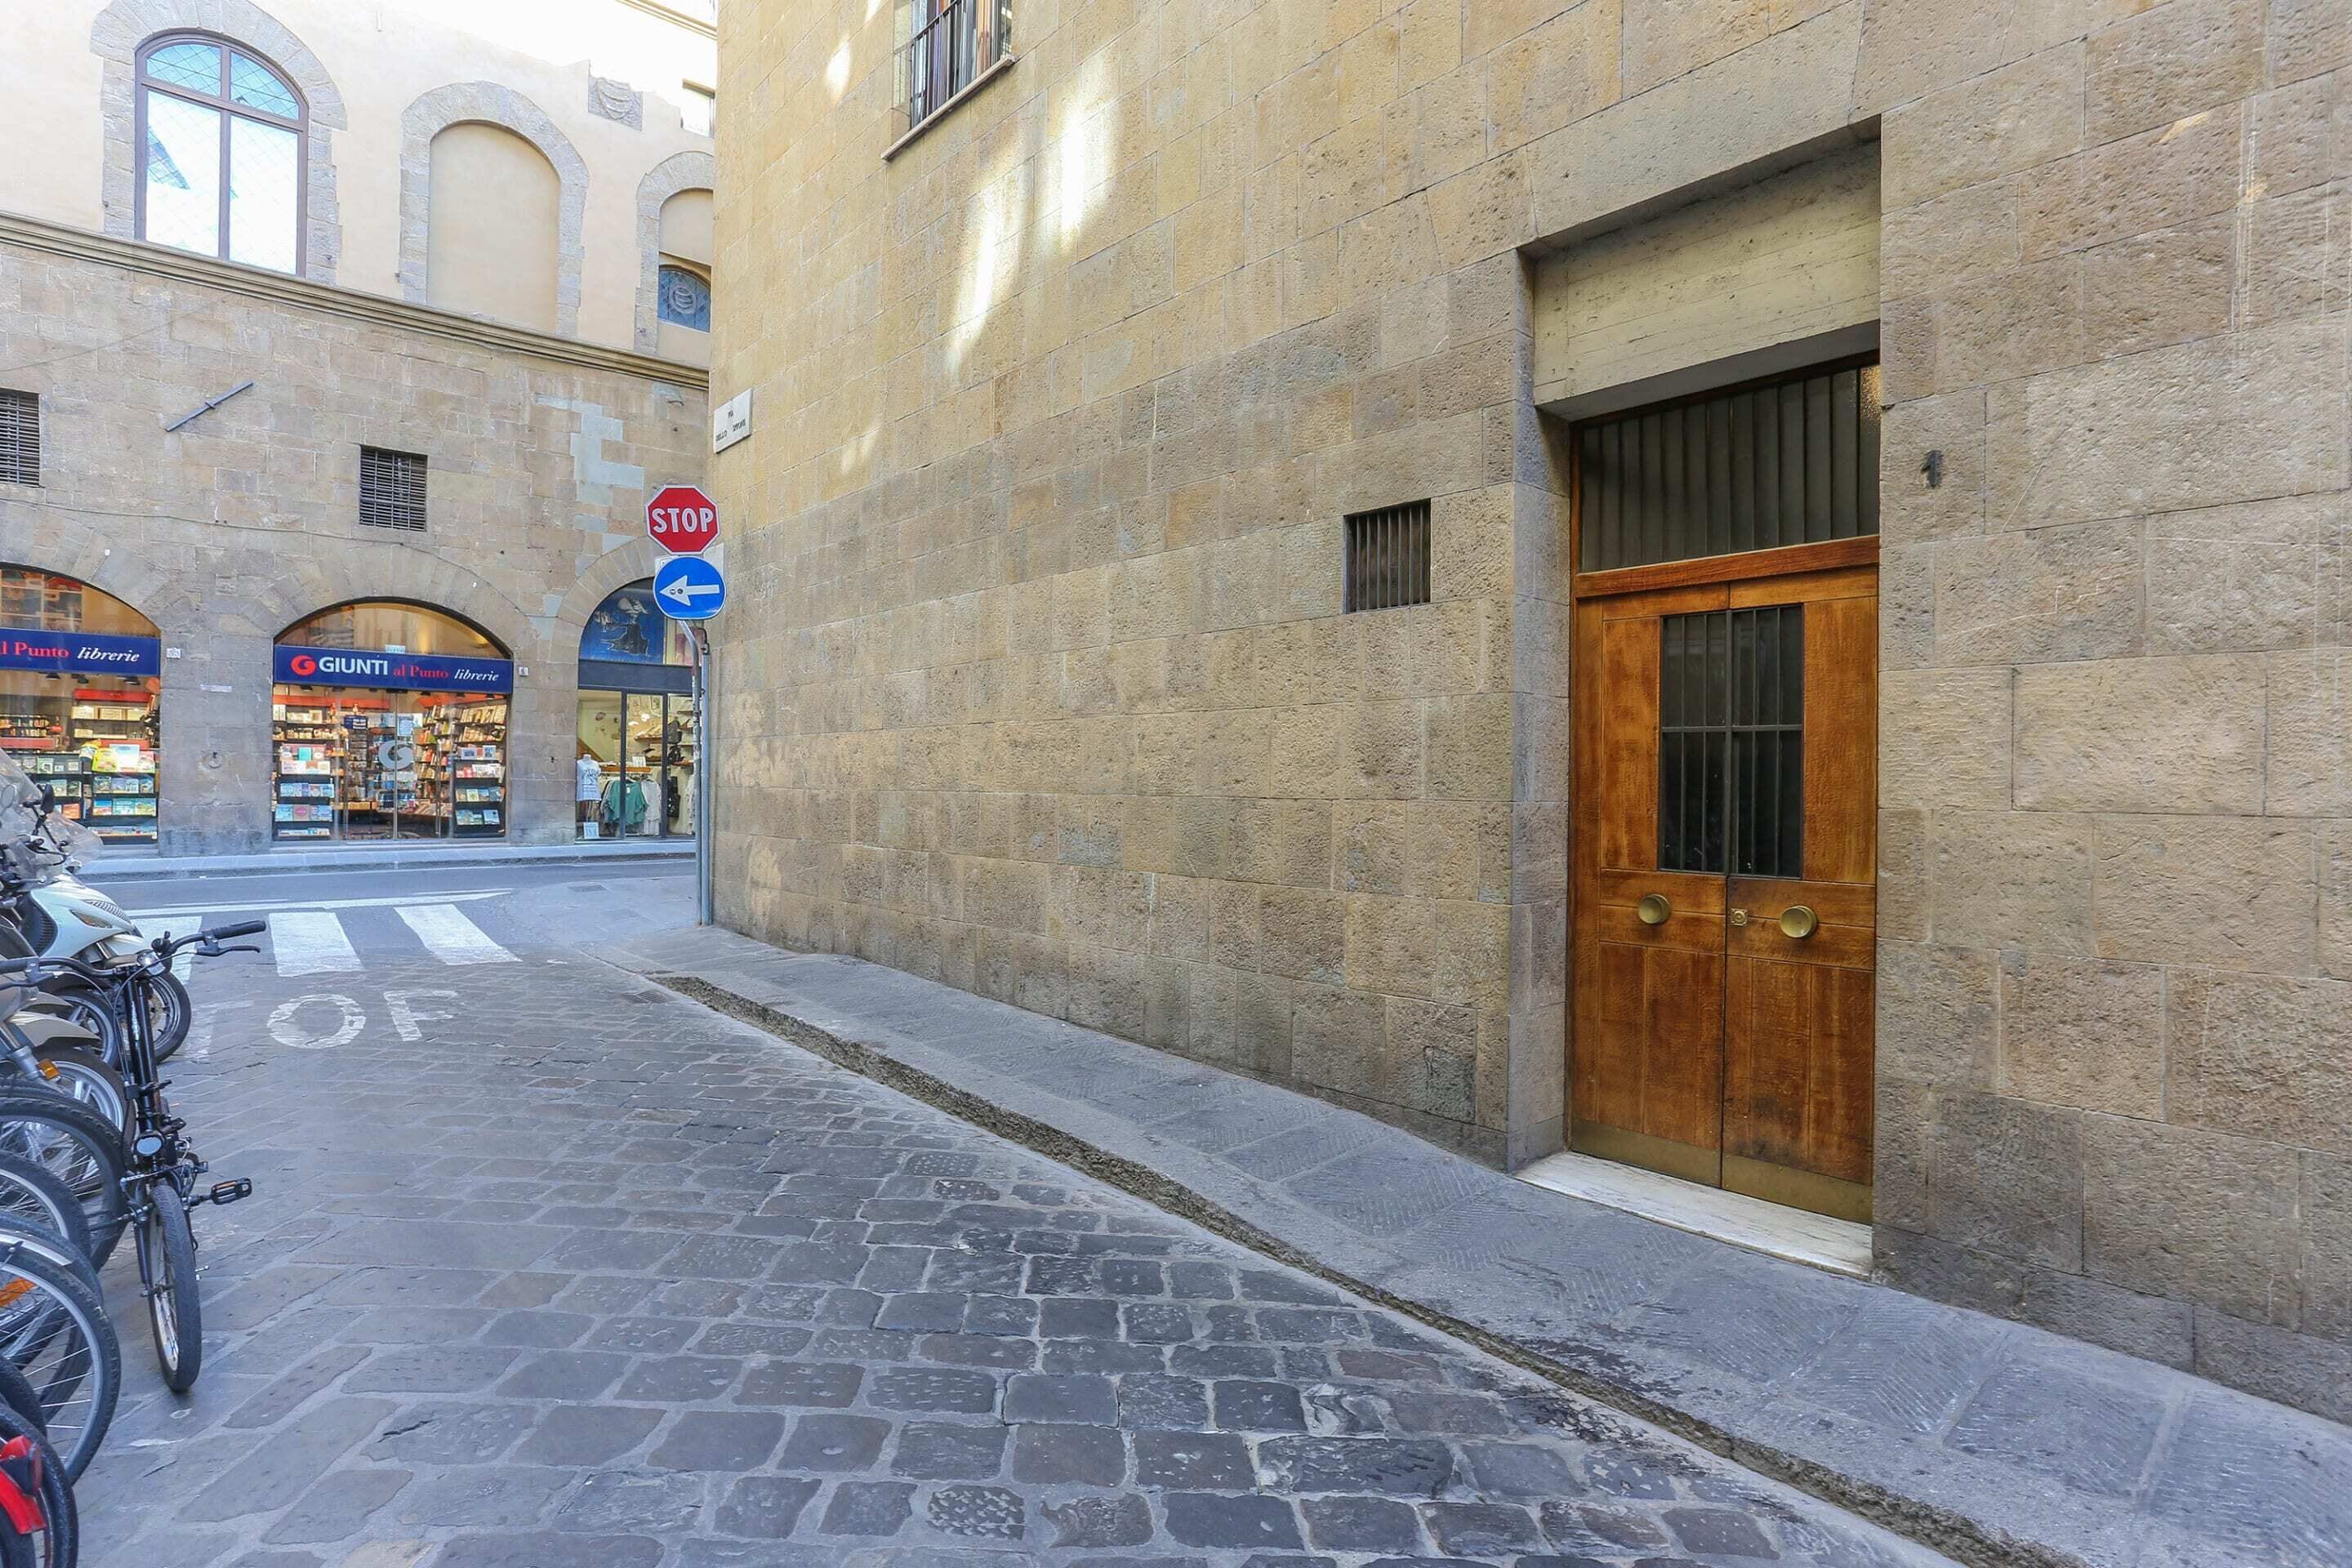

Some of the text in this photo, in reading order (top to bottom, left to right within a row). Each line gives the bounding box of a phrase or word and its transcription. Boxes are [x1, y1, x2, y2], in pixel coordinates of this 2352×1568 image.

[652, 507, 714, 533] STOP
[14, 641, 69, 658] Punto
[77, 646, 140, 662] librerie
[318, 657, 389, 675] GIUNTI
[393, 664, 407, 677] al
[409, 665, 450, 679] Punto
[454, 669, 500, 682] librerie
